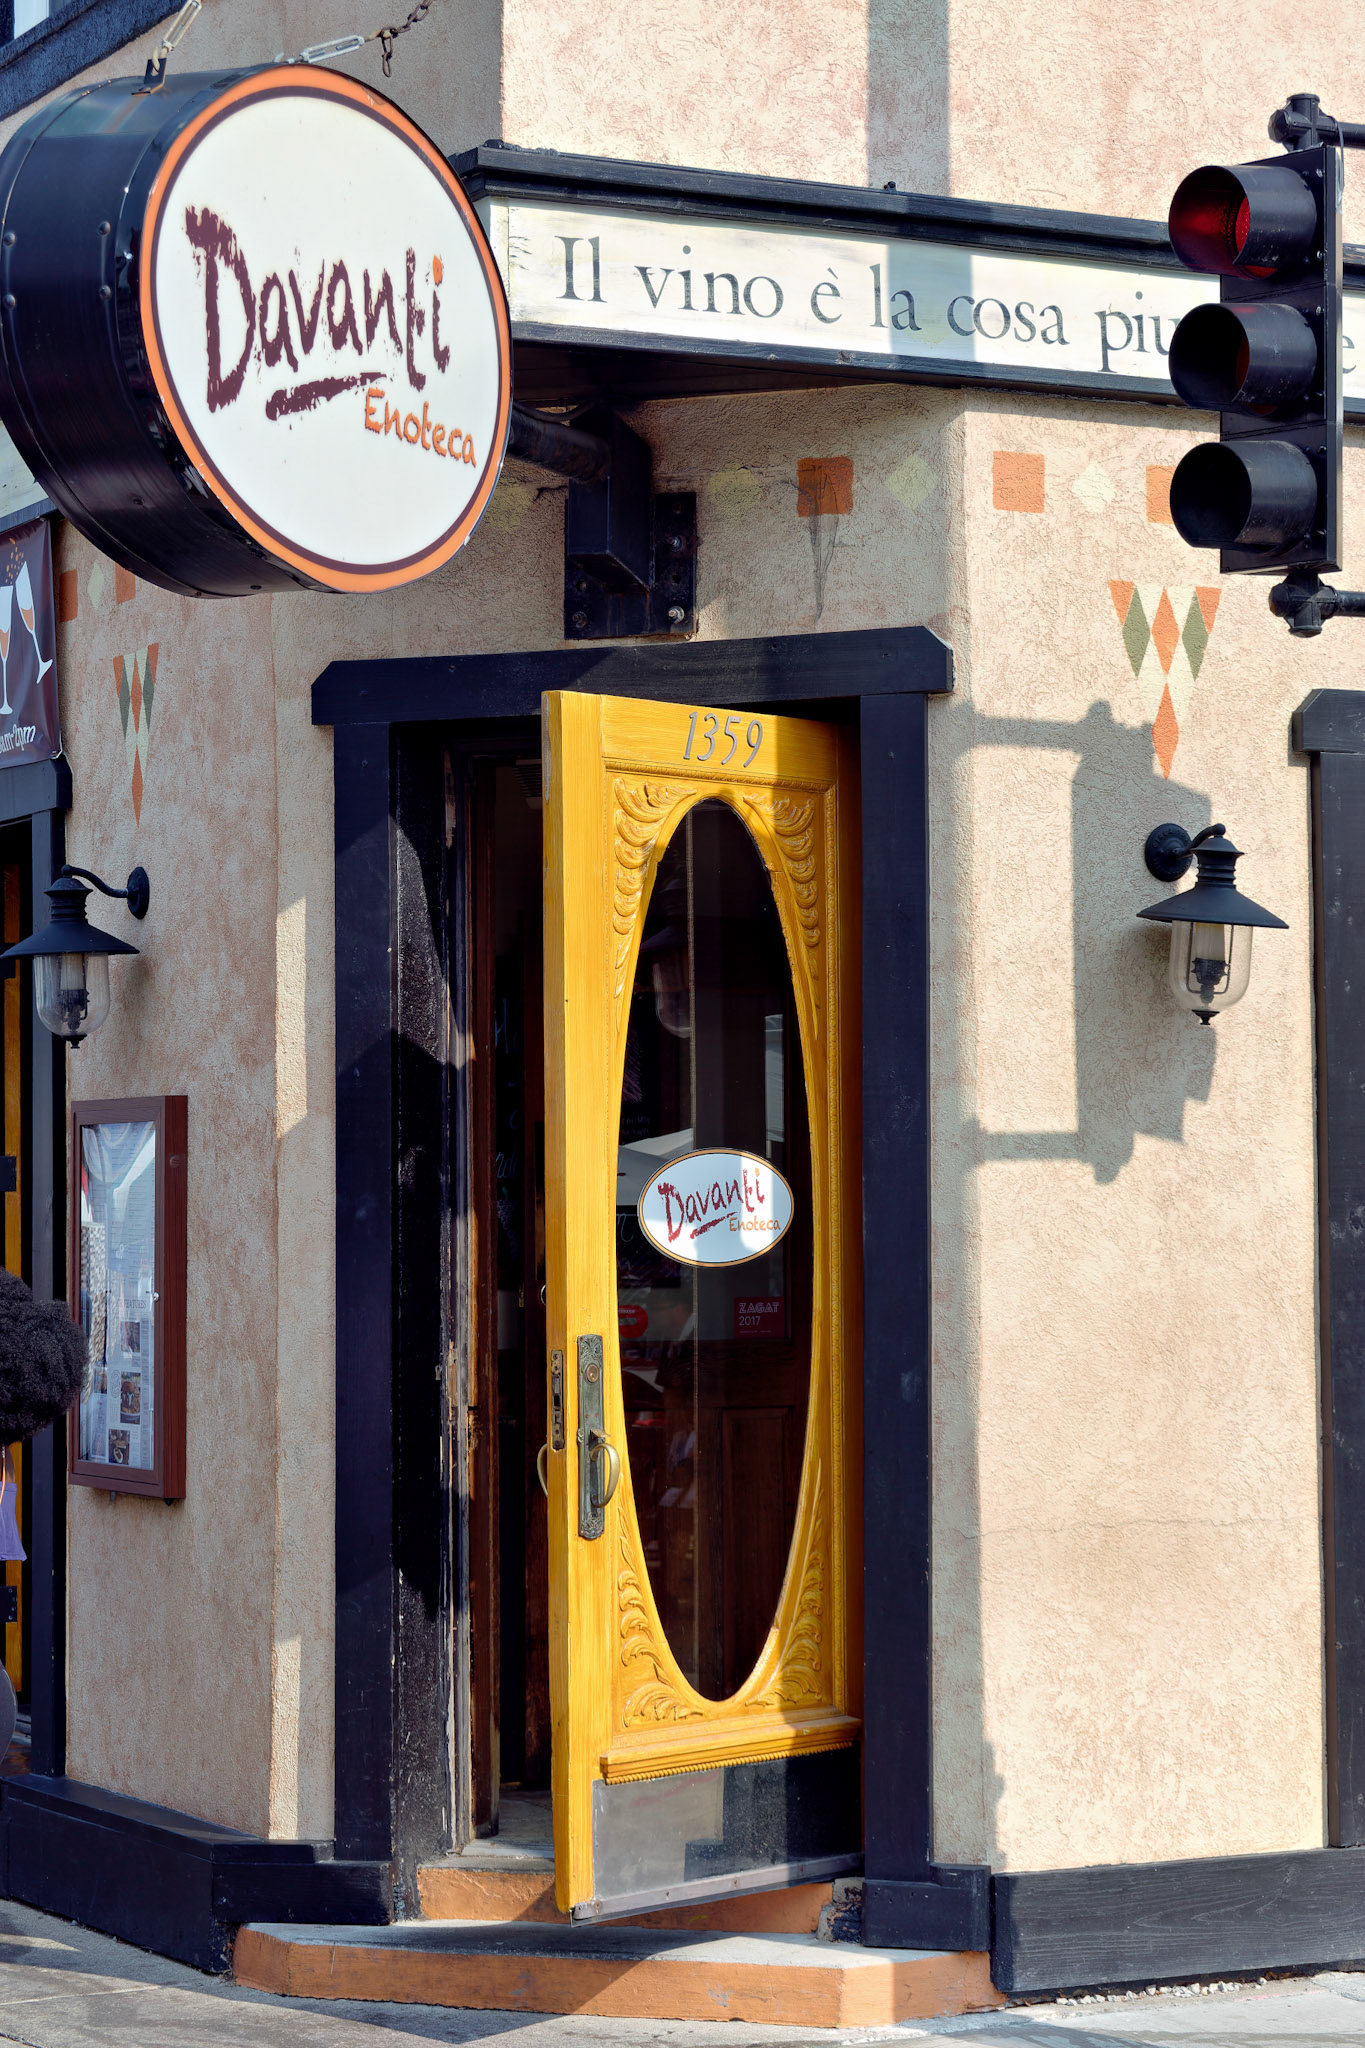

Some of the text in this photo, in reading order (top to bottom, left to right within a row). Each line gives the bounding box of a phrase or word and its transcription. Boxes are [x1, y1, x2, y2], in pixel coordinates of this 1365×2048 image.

[185, 205, 450, 413] Davanti
[554, 235, 608, 303] Il
[634, 245, 784, 318] vino
[810, 267, 842, 324] è
[869, 263, 922, 331] la
[947, 295, 1071, 345] cosa
[364, 387, 477, 468] Enoteca
[683, 711, 764, 768] 1359
[657, 1167, 765, 1243] Davanti
[729, 1216, 781, 1232] Enoteca
[738, 1301, 780, 1314] ZAGAT
[738, 1315, 761, 1326] 2017
